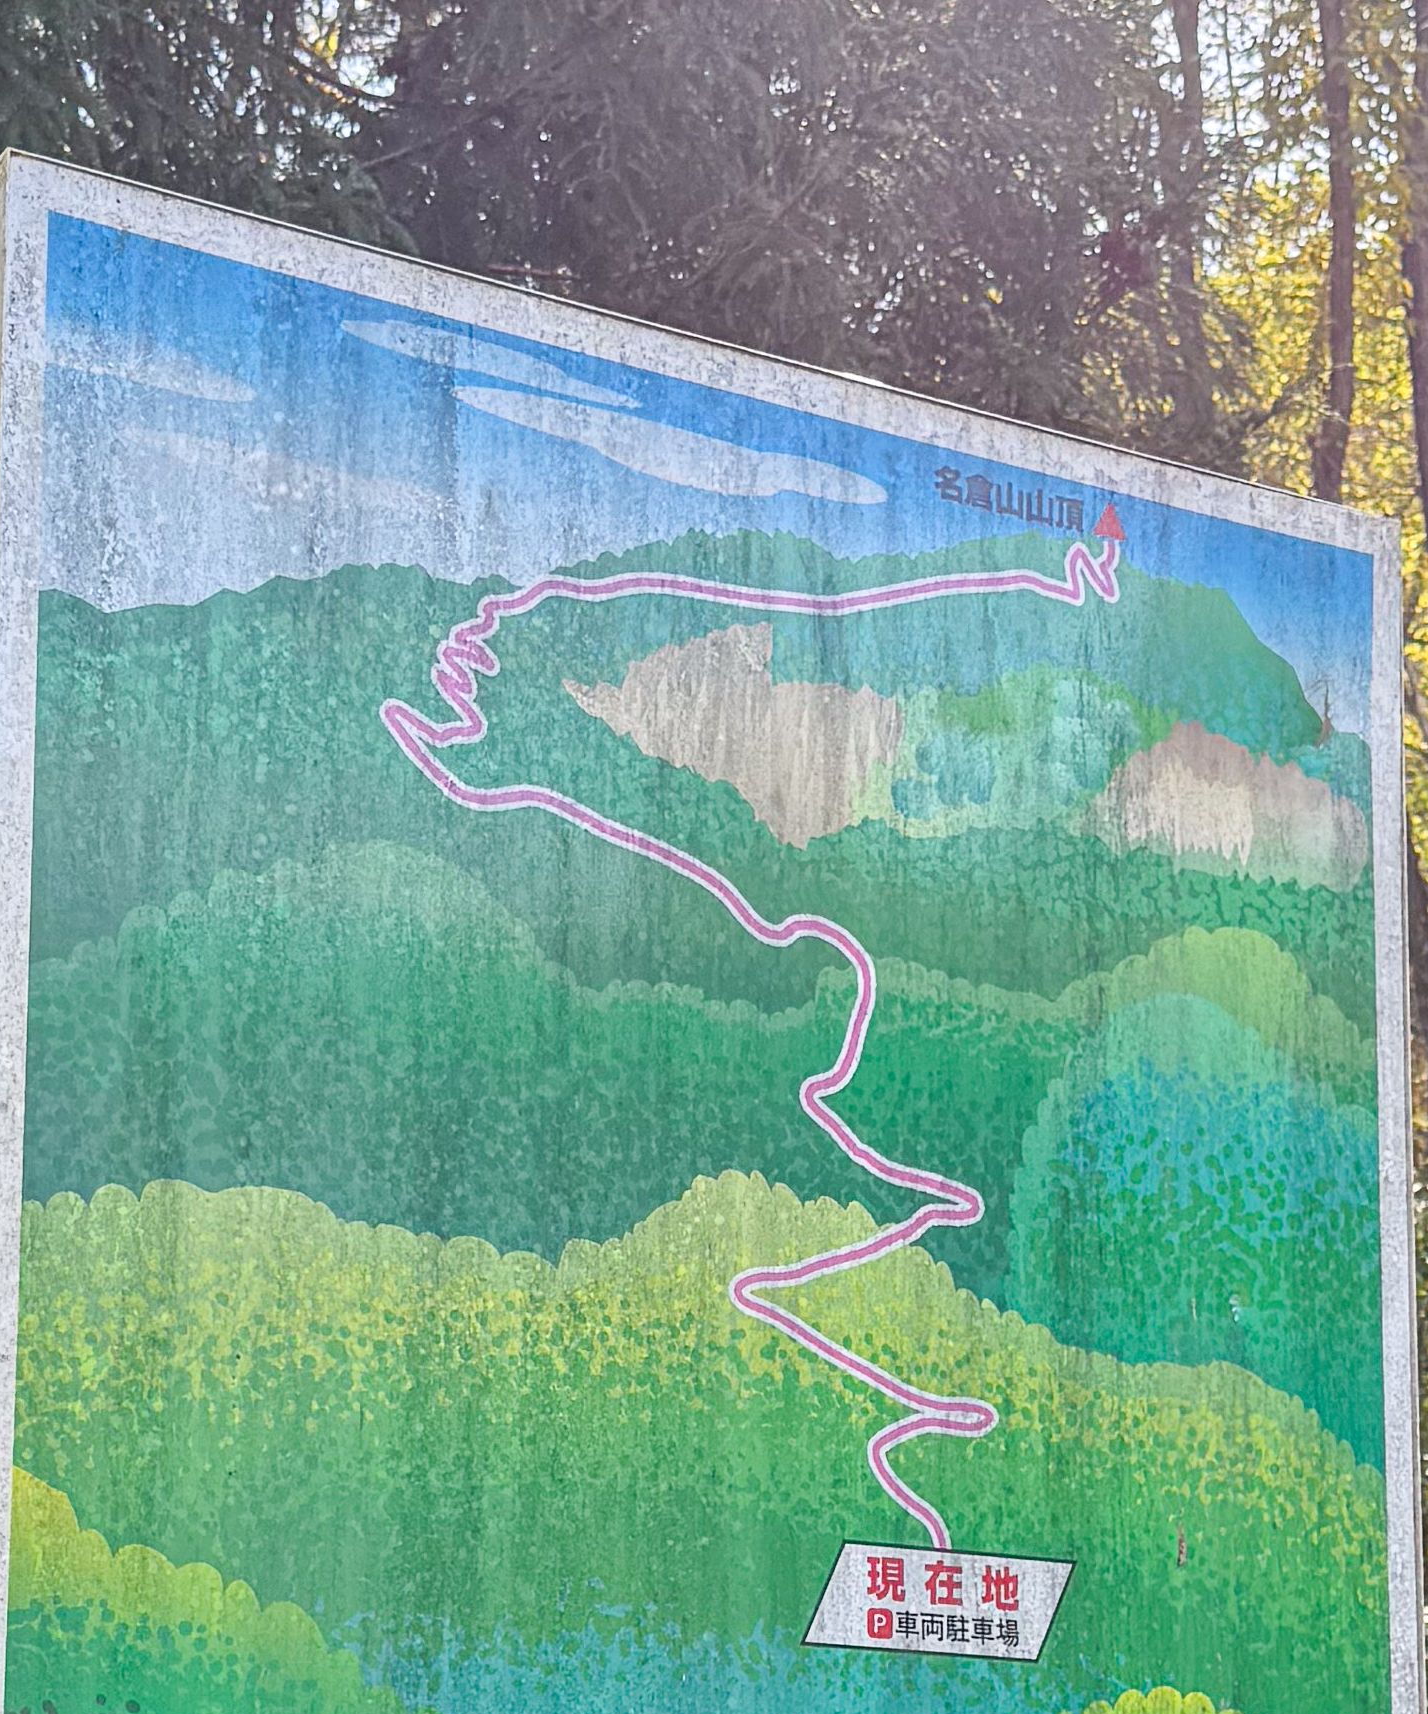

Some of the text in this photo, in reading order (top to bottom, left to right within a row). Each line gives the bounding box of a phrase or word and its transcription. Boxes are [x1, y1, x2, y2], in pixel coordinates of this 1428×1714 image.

[934, 465, 1084, 533] 名倉山山頂
[866, 1556, 1020, 1612] 現在地
[895, 1610, 1020, 1648] 車両駐車場
